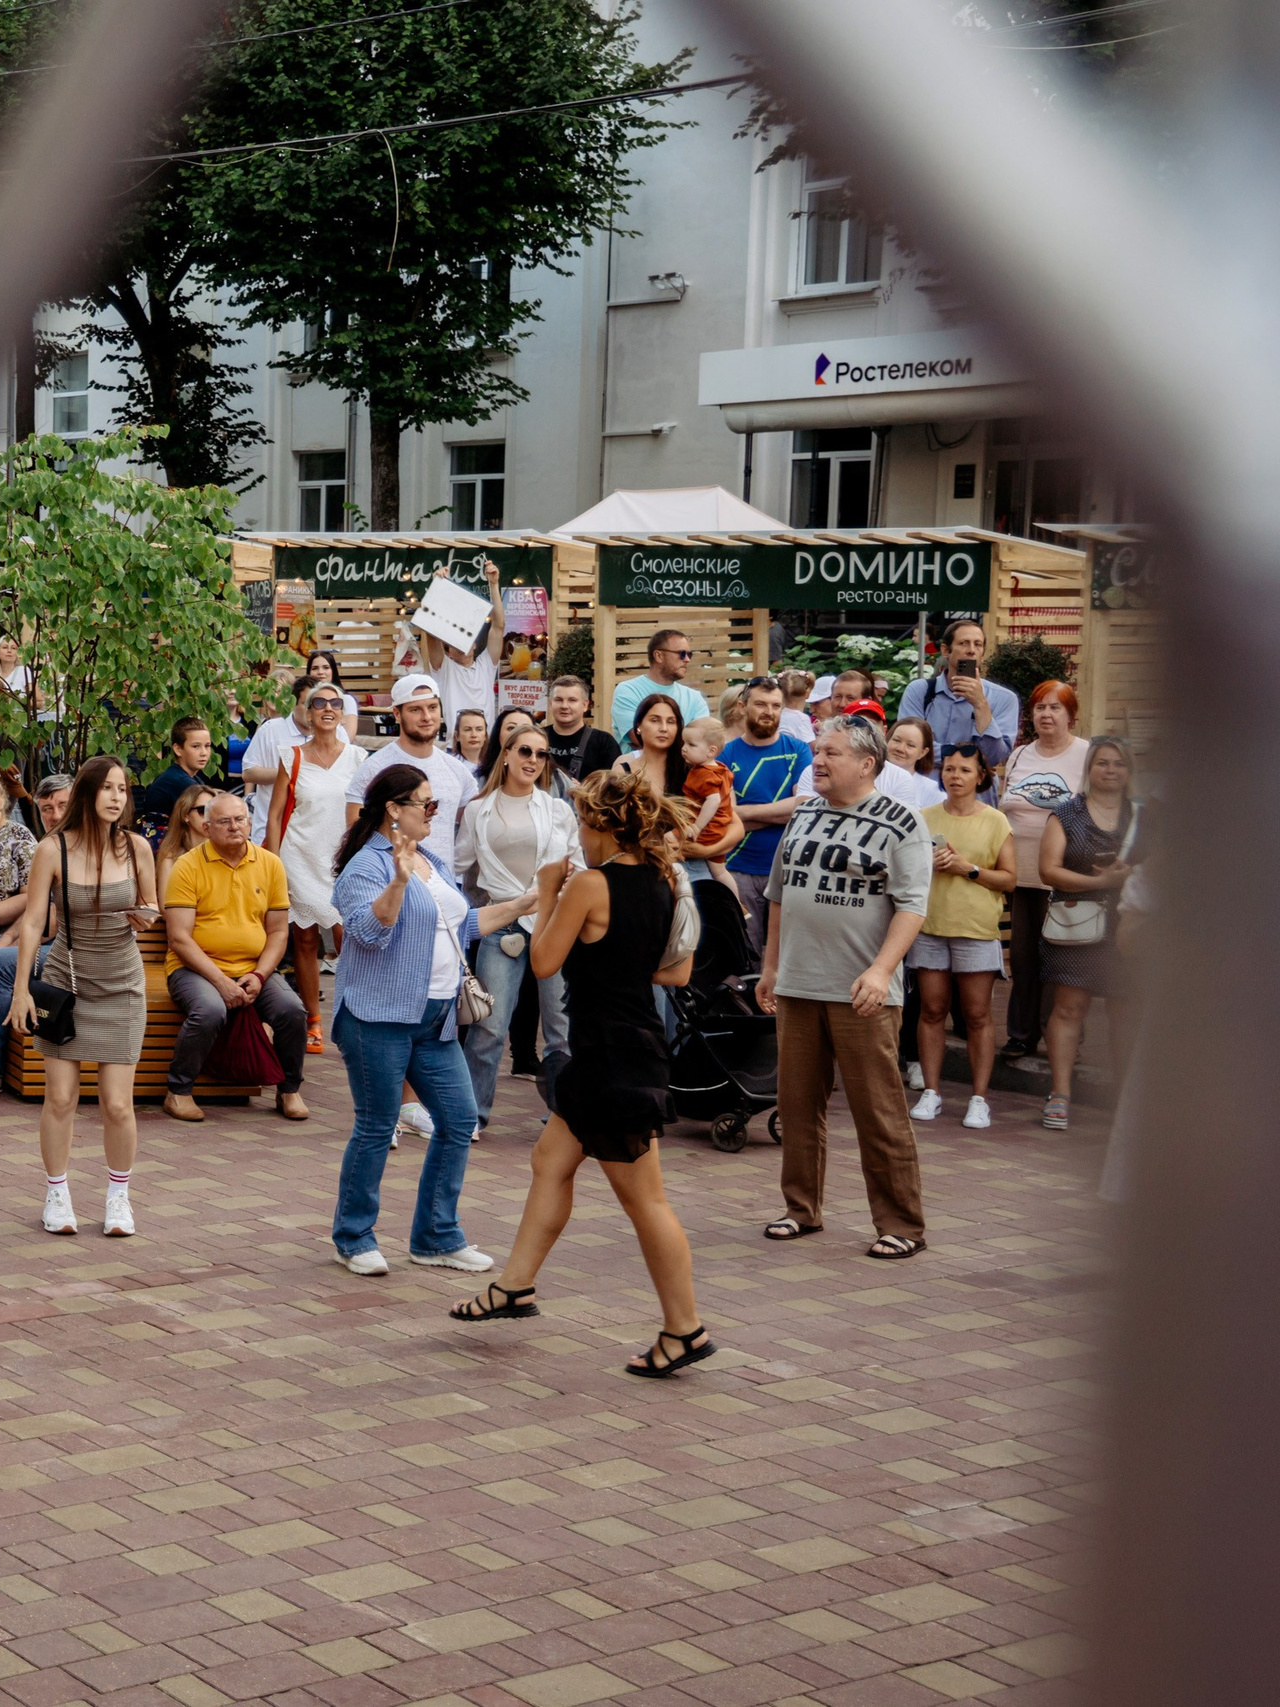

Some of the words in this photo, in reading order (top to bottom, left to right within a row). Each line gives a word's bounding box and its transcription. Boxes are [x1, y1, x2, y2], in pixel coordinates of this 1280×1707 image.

[835, 357, 973, 384] Ростелеком
[630, 552, 741, 575] Смоленские
[508, 590, 543, 603] КВАС
[782, 869, 809, 888] UR
[817, 875, 885, 896] LIFE
[814, 893, 865, 908] SINCE/89
